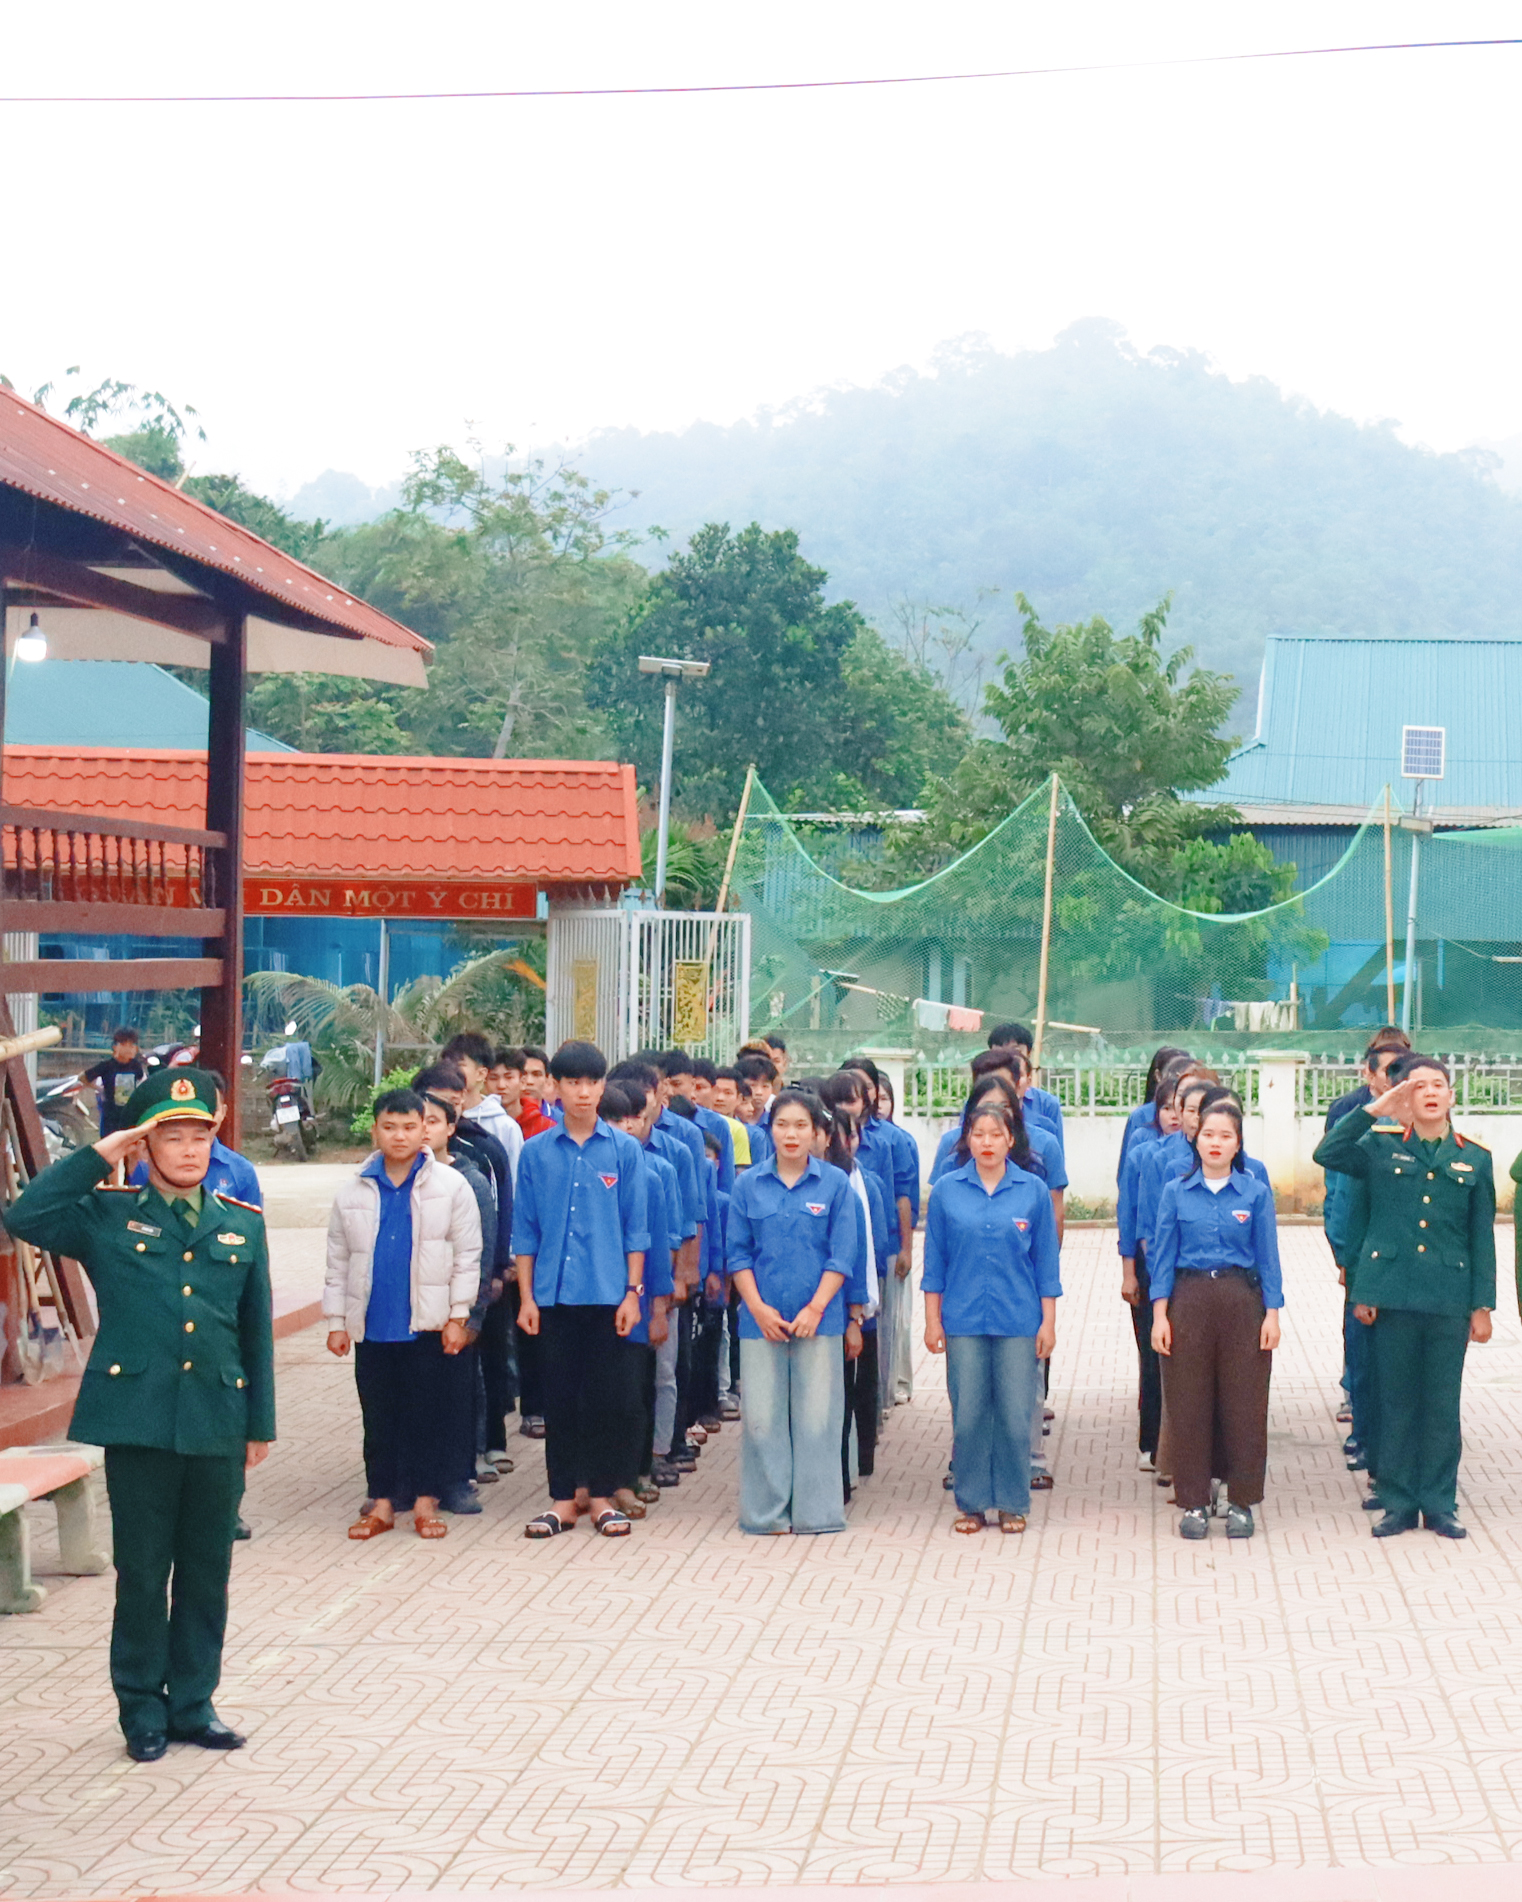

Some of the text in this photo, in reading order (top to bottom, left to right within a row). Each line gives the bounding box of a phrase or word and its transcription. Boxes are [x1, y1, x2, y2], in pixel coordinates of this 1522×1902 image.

[259, 883, 514, 912] DÂN MỘT Ý CHÍ
